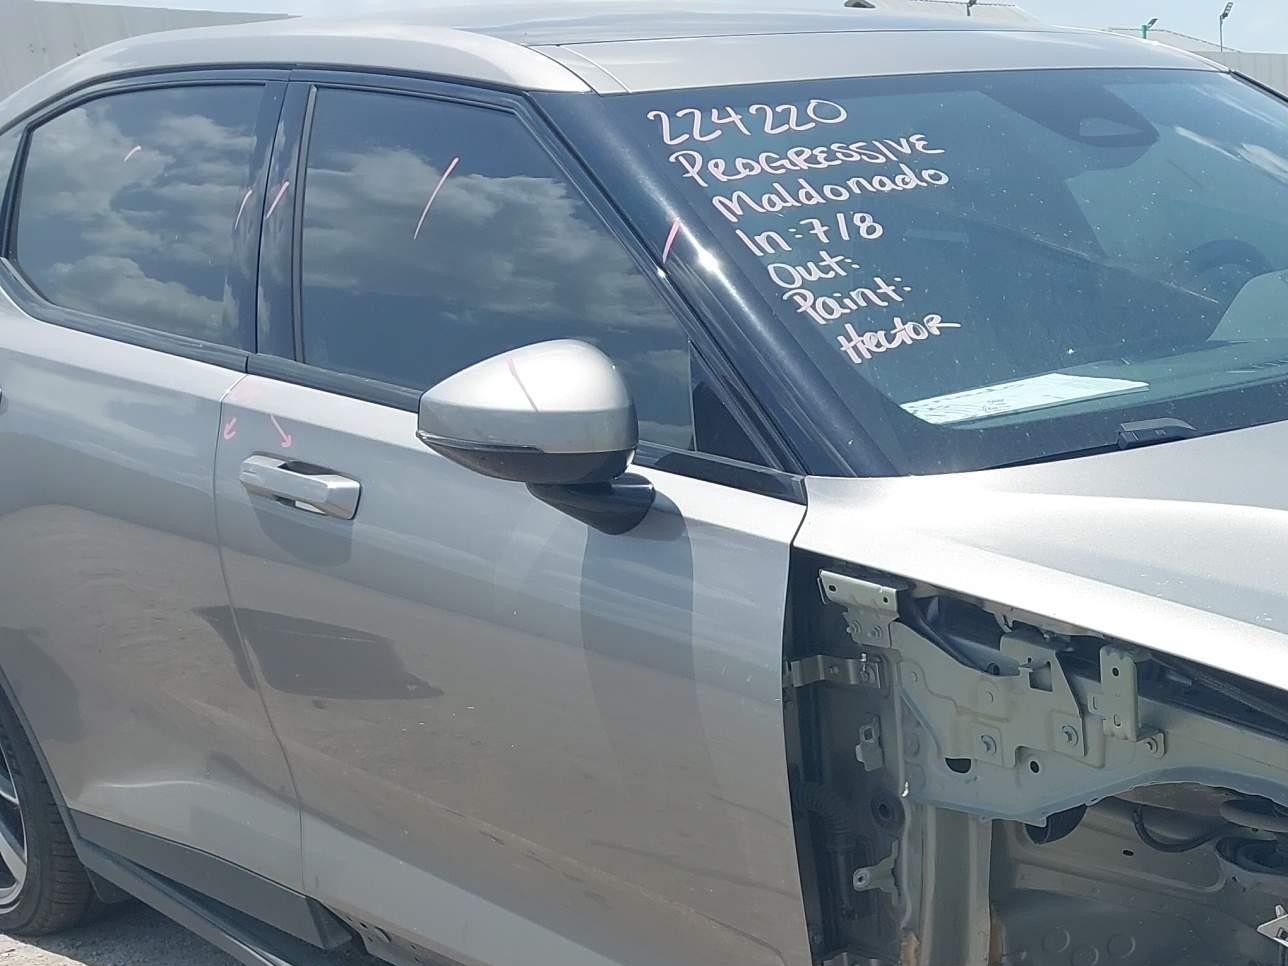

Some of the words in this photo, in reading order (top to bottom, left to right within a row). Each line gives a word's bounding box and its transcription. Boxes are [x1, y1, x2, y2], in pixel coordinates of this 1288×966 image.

[711, 164, 949, 222] Maldonado
[768, 251, 860, 288] Out:
[783, 277, 911, 324] Paint:
